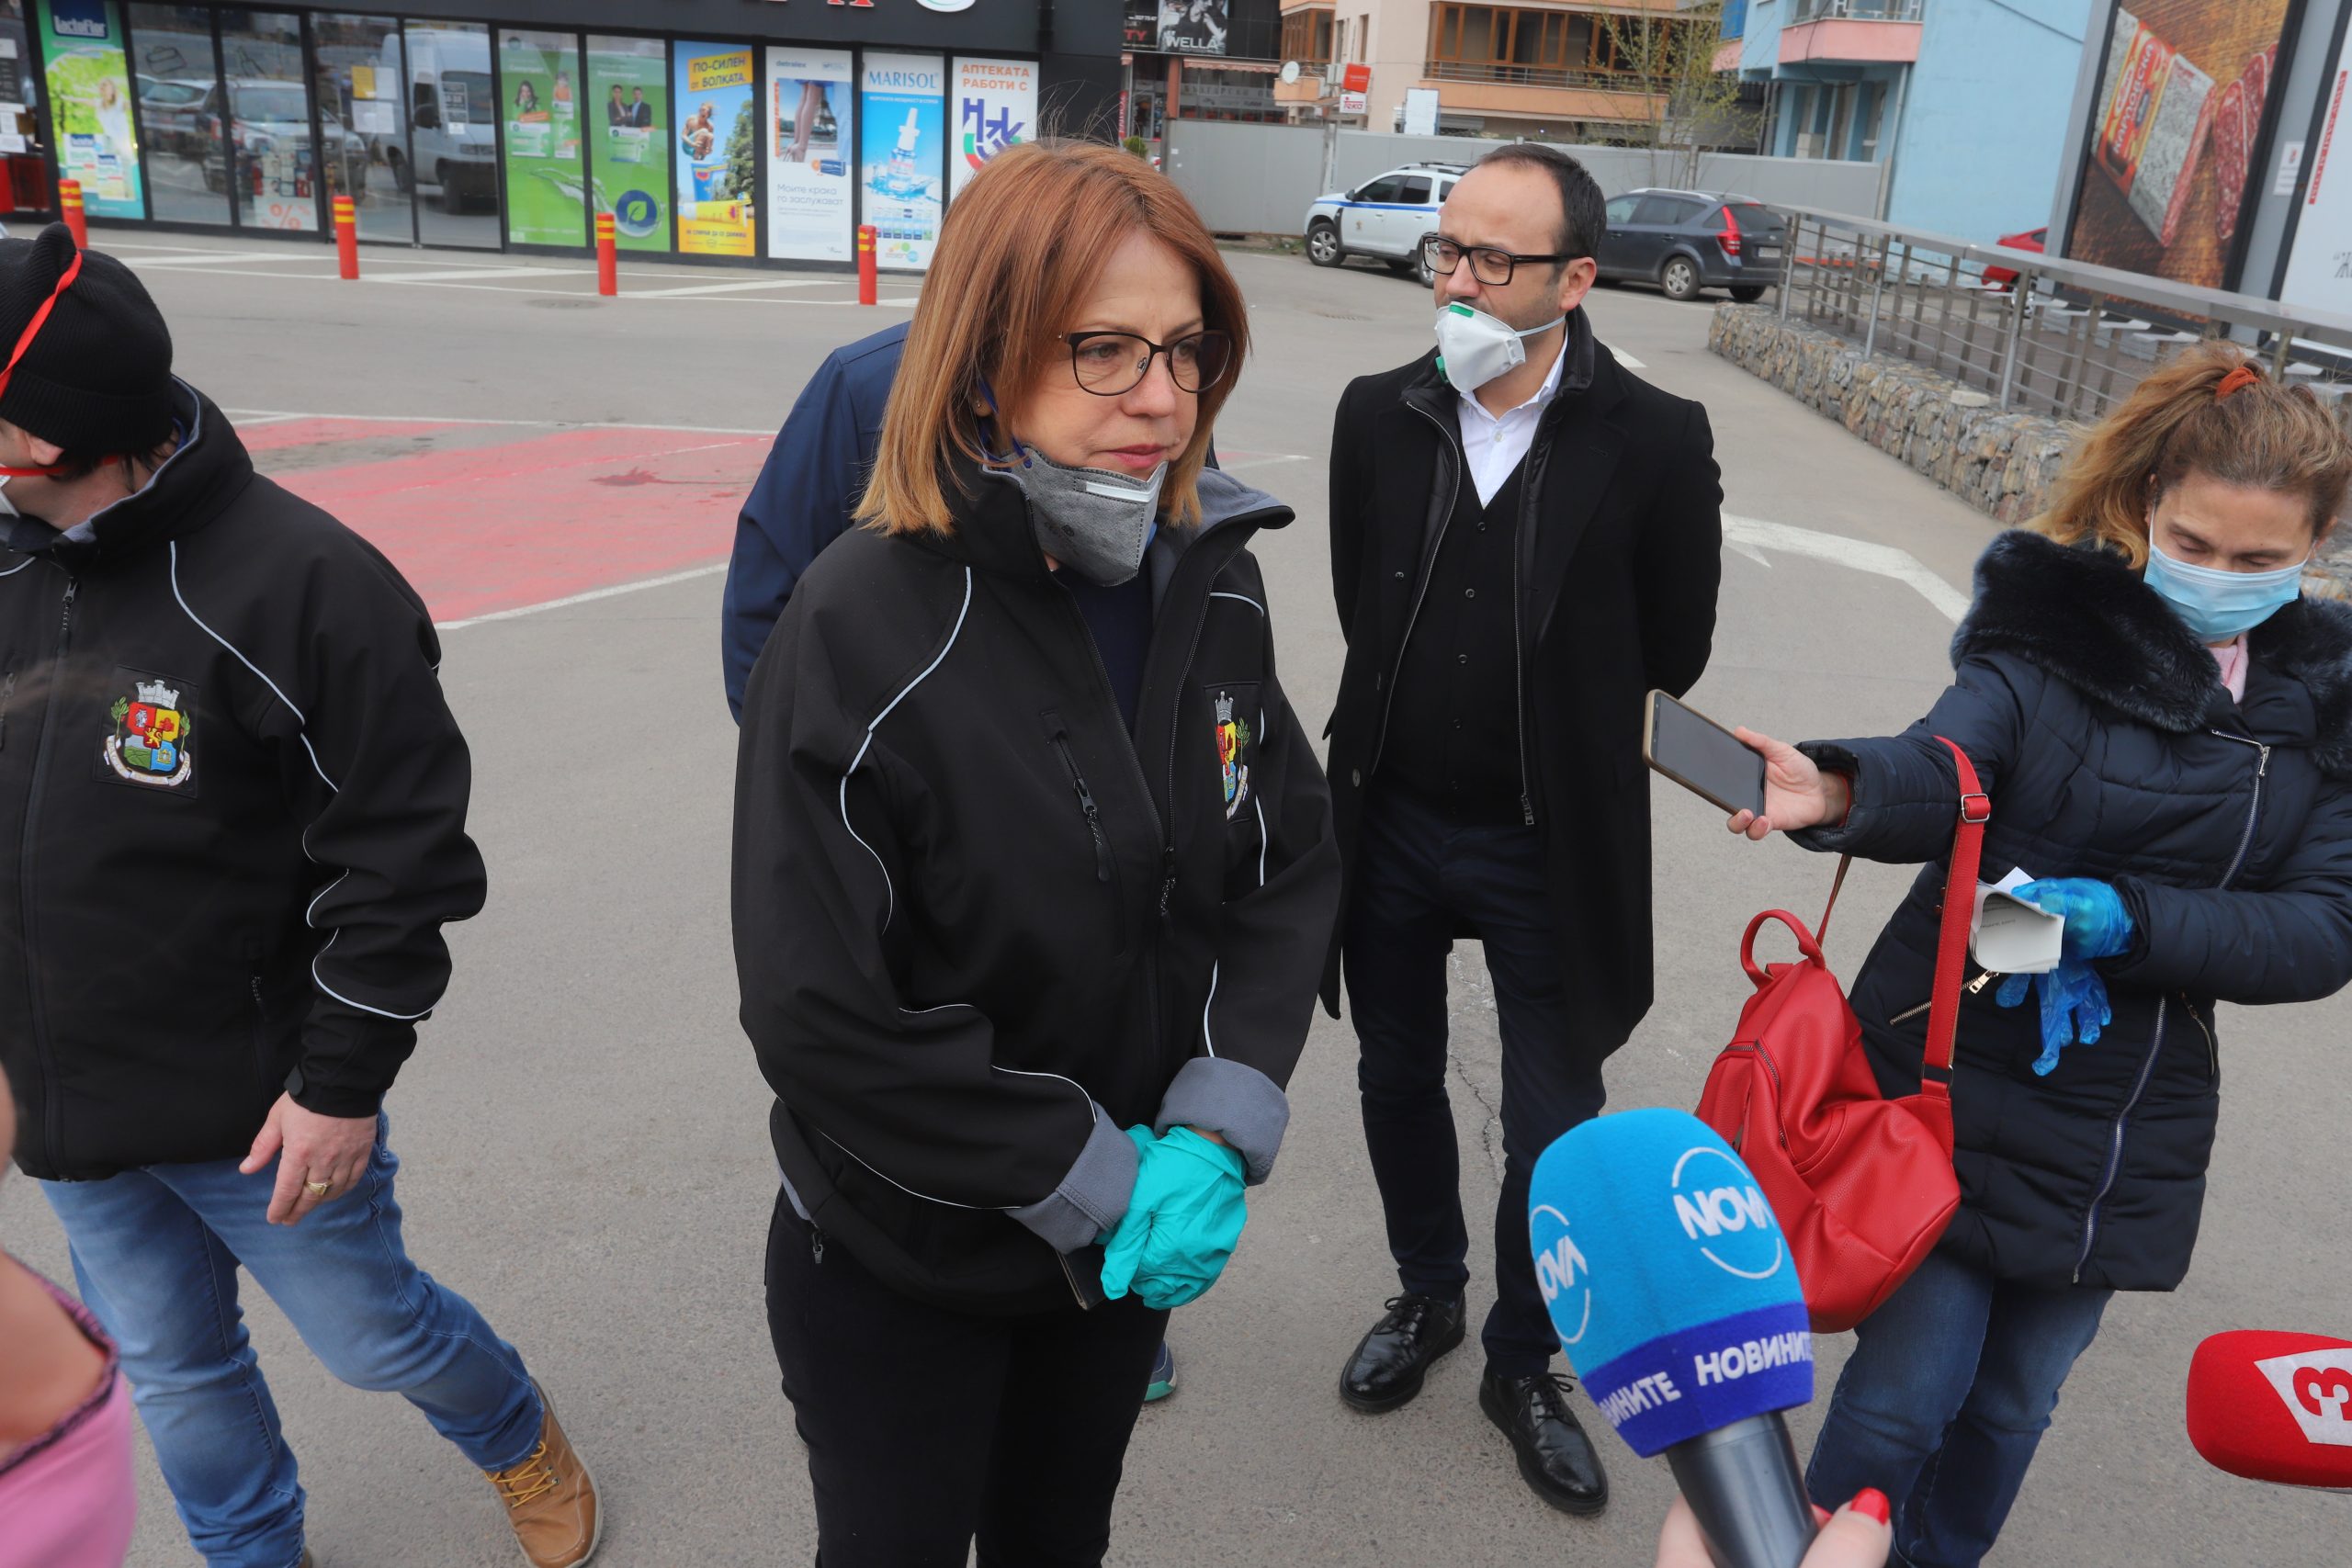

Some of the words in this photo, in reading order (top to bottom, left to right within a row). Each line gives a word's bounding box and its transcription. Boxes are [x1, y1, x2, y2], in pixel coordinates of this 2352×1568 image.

[1165, 36, 1219, 50] WELLA
[693, 56, 746, 73] ПО-СИЛЕН
[962, 64, 1030, 77] АПТЕКАТА
[702, 73, 746, 88] БОЛКАТА
[963, 78, 1014, 90] РАБОТИ
[1534, 1235, 1589, 1307] OVA
[1599, 1371, 1682, 1428] ИНИТЕ
